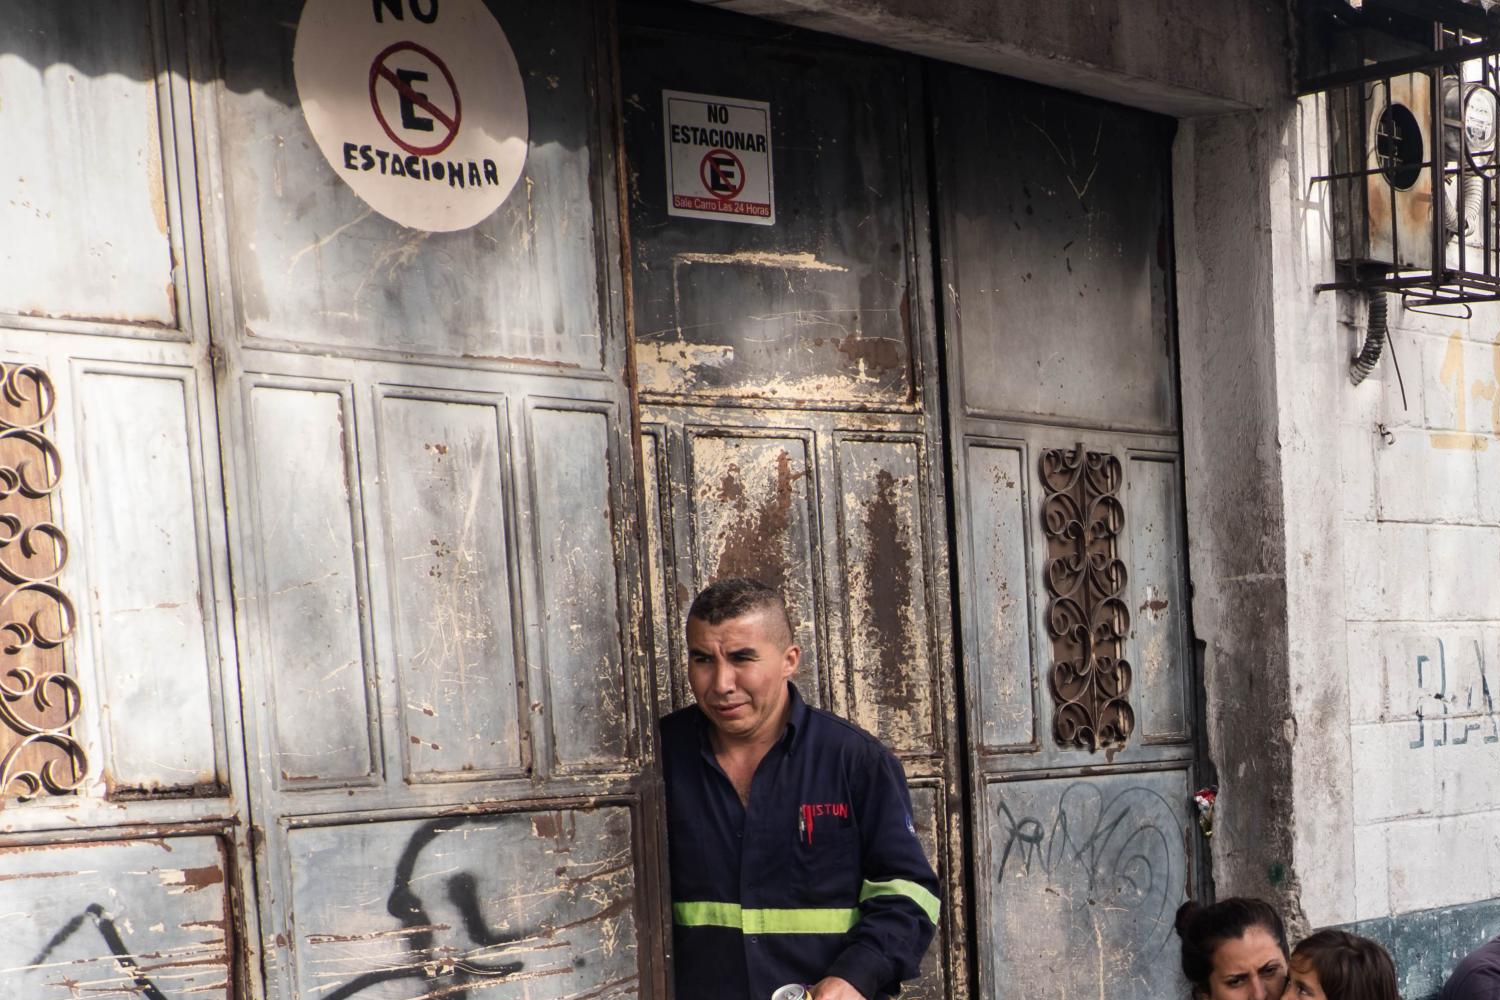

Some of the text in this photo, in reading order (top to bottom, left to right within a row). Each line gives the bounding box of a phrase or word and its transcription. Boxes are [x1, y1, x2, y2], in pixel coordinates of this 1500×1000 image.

[372, 0, 439, 24] NO
[396, 68, 434, 132] E
[707, 103, 729, 125] NO
[671, 124, 767, 153] ESTACIONAR
[342, 141, 500, 189] ESTACIONAR
[710, 156, 737, 192] E
[674, 195, 770, 216] Sale Carro Las 24 Horas
